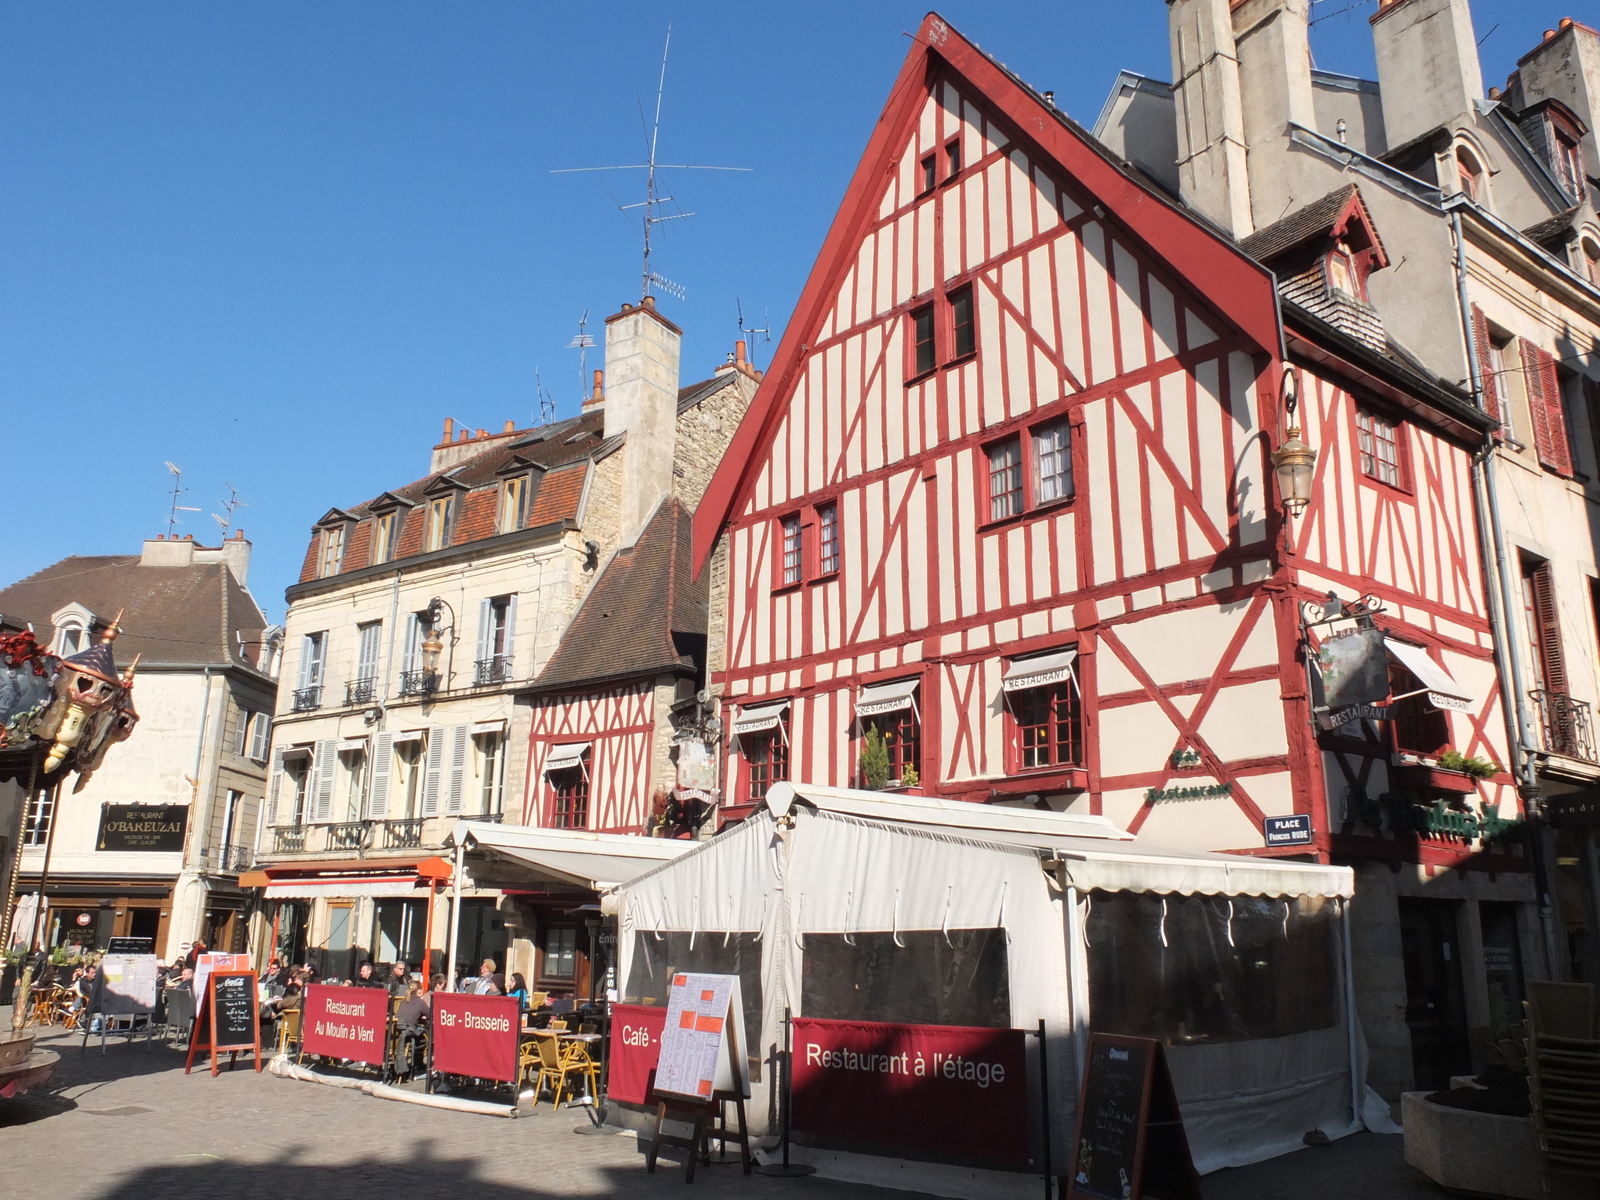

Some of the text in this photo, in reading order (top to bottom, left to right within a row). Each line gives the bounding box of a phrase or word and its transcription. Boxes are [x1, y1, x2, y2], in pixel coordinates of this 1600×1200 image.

[1339, 627, 1358, 639] BAR
[1008, 669, 1065, 689] RESTAURANT
[860, 698, 907, 714] RESTAURANT
[1430, 692, 1470, 711] RESTAURANT
[737, 719, 775, 732] RESTAURANT
[1329, 705, 1389, 729] RESTAURANT
[1172, 750, 1202, 764] Bar
[1147, 782, 1233, 803] Restaurant
[1275, 819, 1301, 830] PLACE
[1291, 829, 1309, 840] RUDE
[325, 997, 365, 1018] Restaurant
[439, 1009, 456, 1026] Bar
[464, 1011, 510, 1032] Brasserie
[314, 1020, 375, 1043] Au Moulin à Vent
[622, 1024, 650, 1048] Café
[806, 1042, 1006, 1088] Restaurant à l'étage
